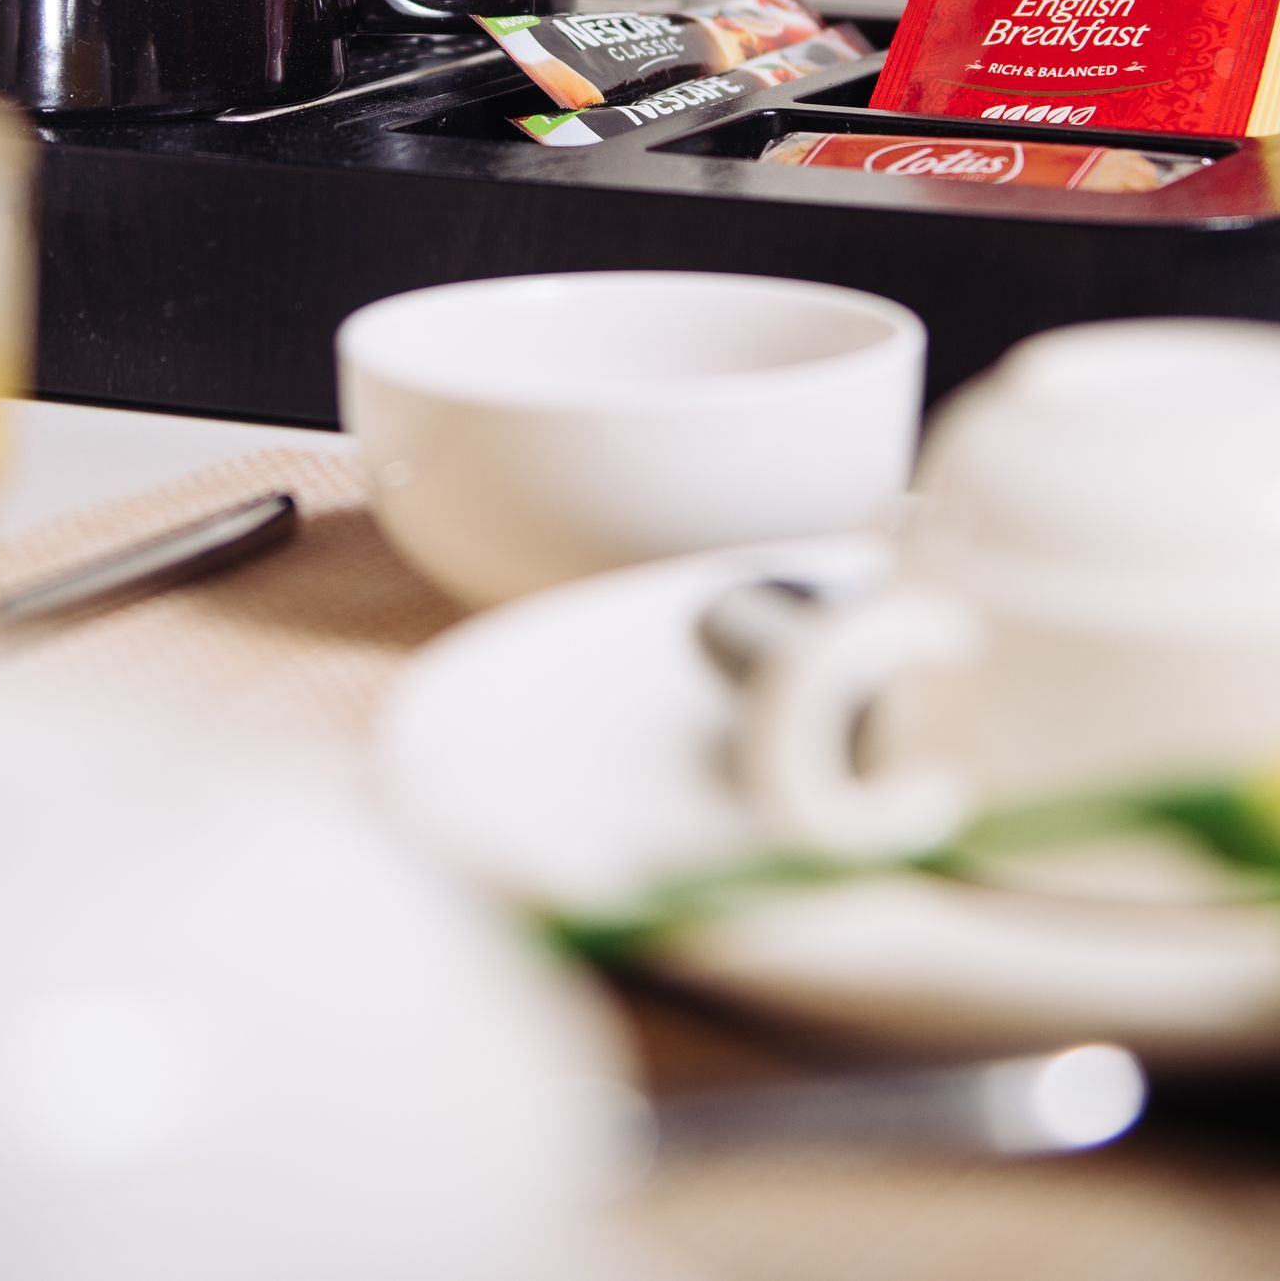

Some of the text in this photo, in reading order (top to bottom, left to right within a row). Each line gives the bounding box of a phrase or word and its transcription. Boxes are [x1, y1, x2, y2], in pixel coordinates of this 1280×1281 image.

[608, 35, 685, 62] CLASSIC
[981, 18, 1151, 52] Breakfast
[987, 62, 1118, 78] RICH & BALANCED
